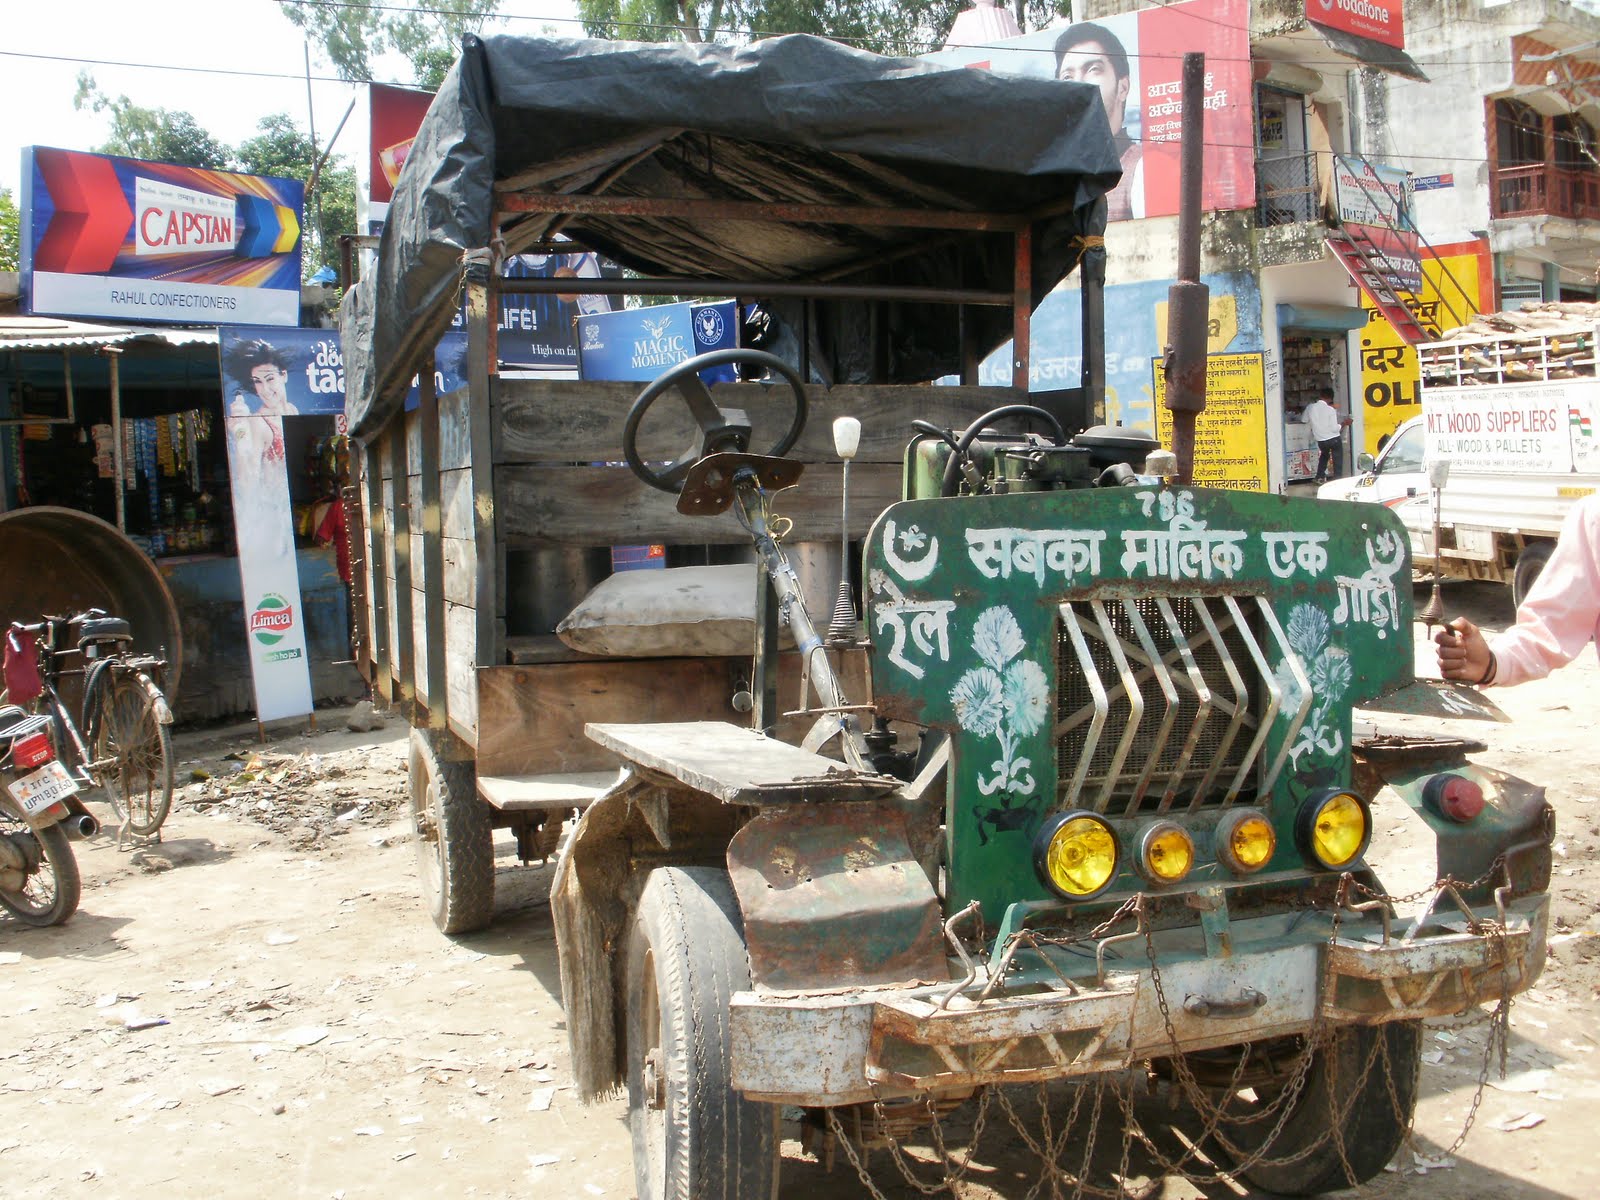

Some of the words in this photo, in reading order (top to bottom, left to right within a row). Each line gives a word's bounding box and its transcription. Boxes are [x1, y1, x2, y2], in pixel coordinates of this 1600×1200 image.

[141, 207, 231, 247] CAPSTAN
[111, 291, 146, 305] RAHUL
[150, 293, 237, 310] CONFECTIONERS
[532, 344, 553, 357] High
[634, 336, 684, 357] MAGIC
[631, 350, 688, 368] MOMENTS
[1427, 413, 1445, 433] M.T.
[1447, 412, 1481, 433] WOOD
[1487, 408, 1557, 433] SUPPLIERS
[1457, 439, 1482, 453] WOOD
[1486, 440, 1491, 452] &
[1496, 439, 1542, 453] PALLETS
[1135, 489, 1194, 521] 786
[965, 527, 1106, 589] सबका
[1120, 514, 1247, 582] मालिक
[1261, 531, 1329, 578] एक
[252, 613, 290, 628] Limca
[32, 750, 48, 762] STOP
